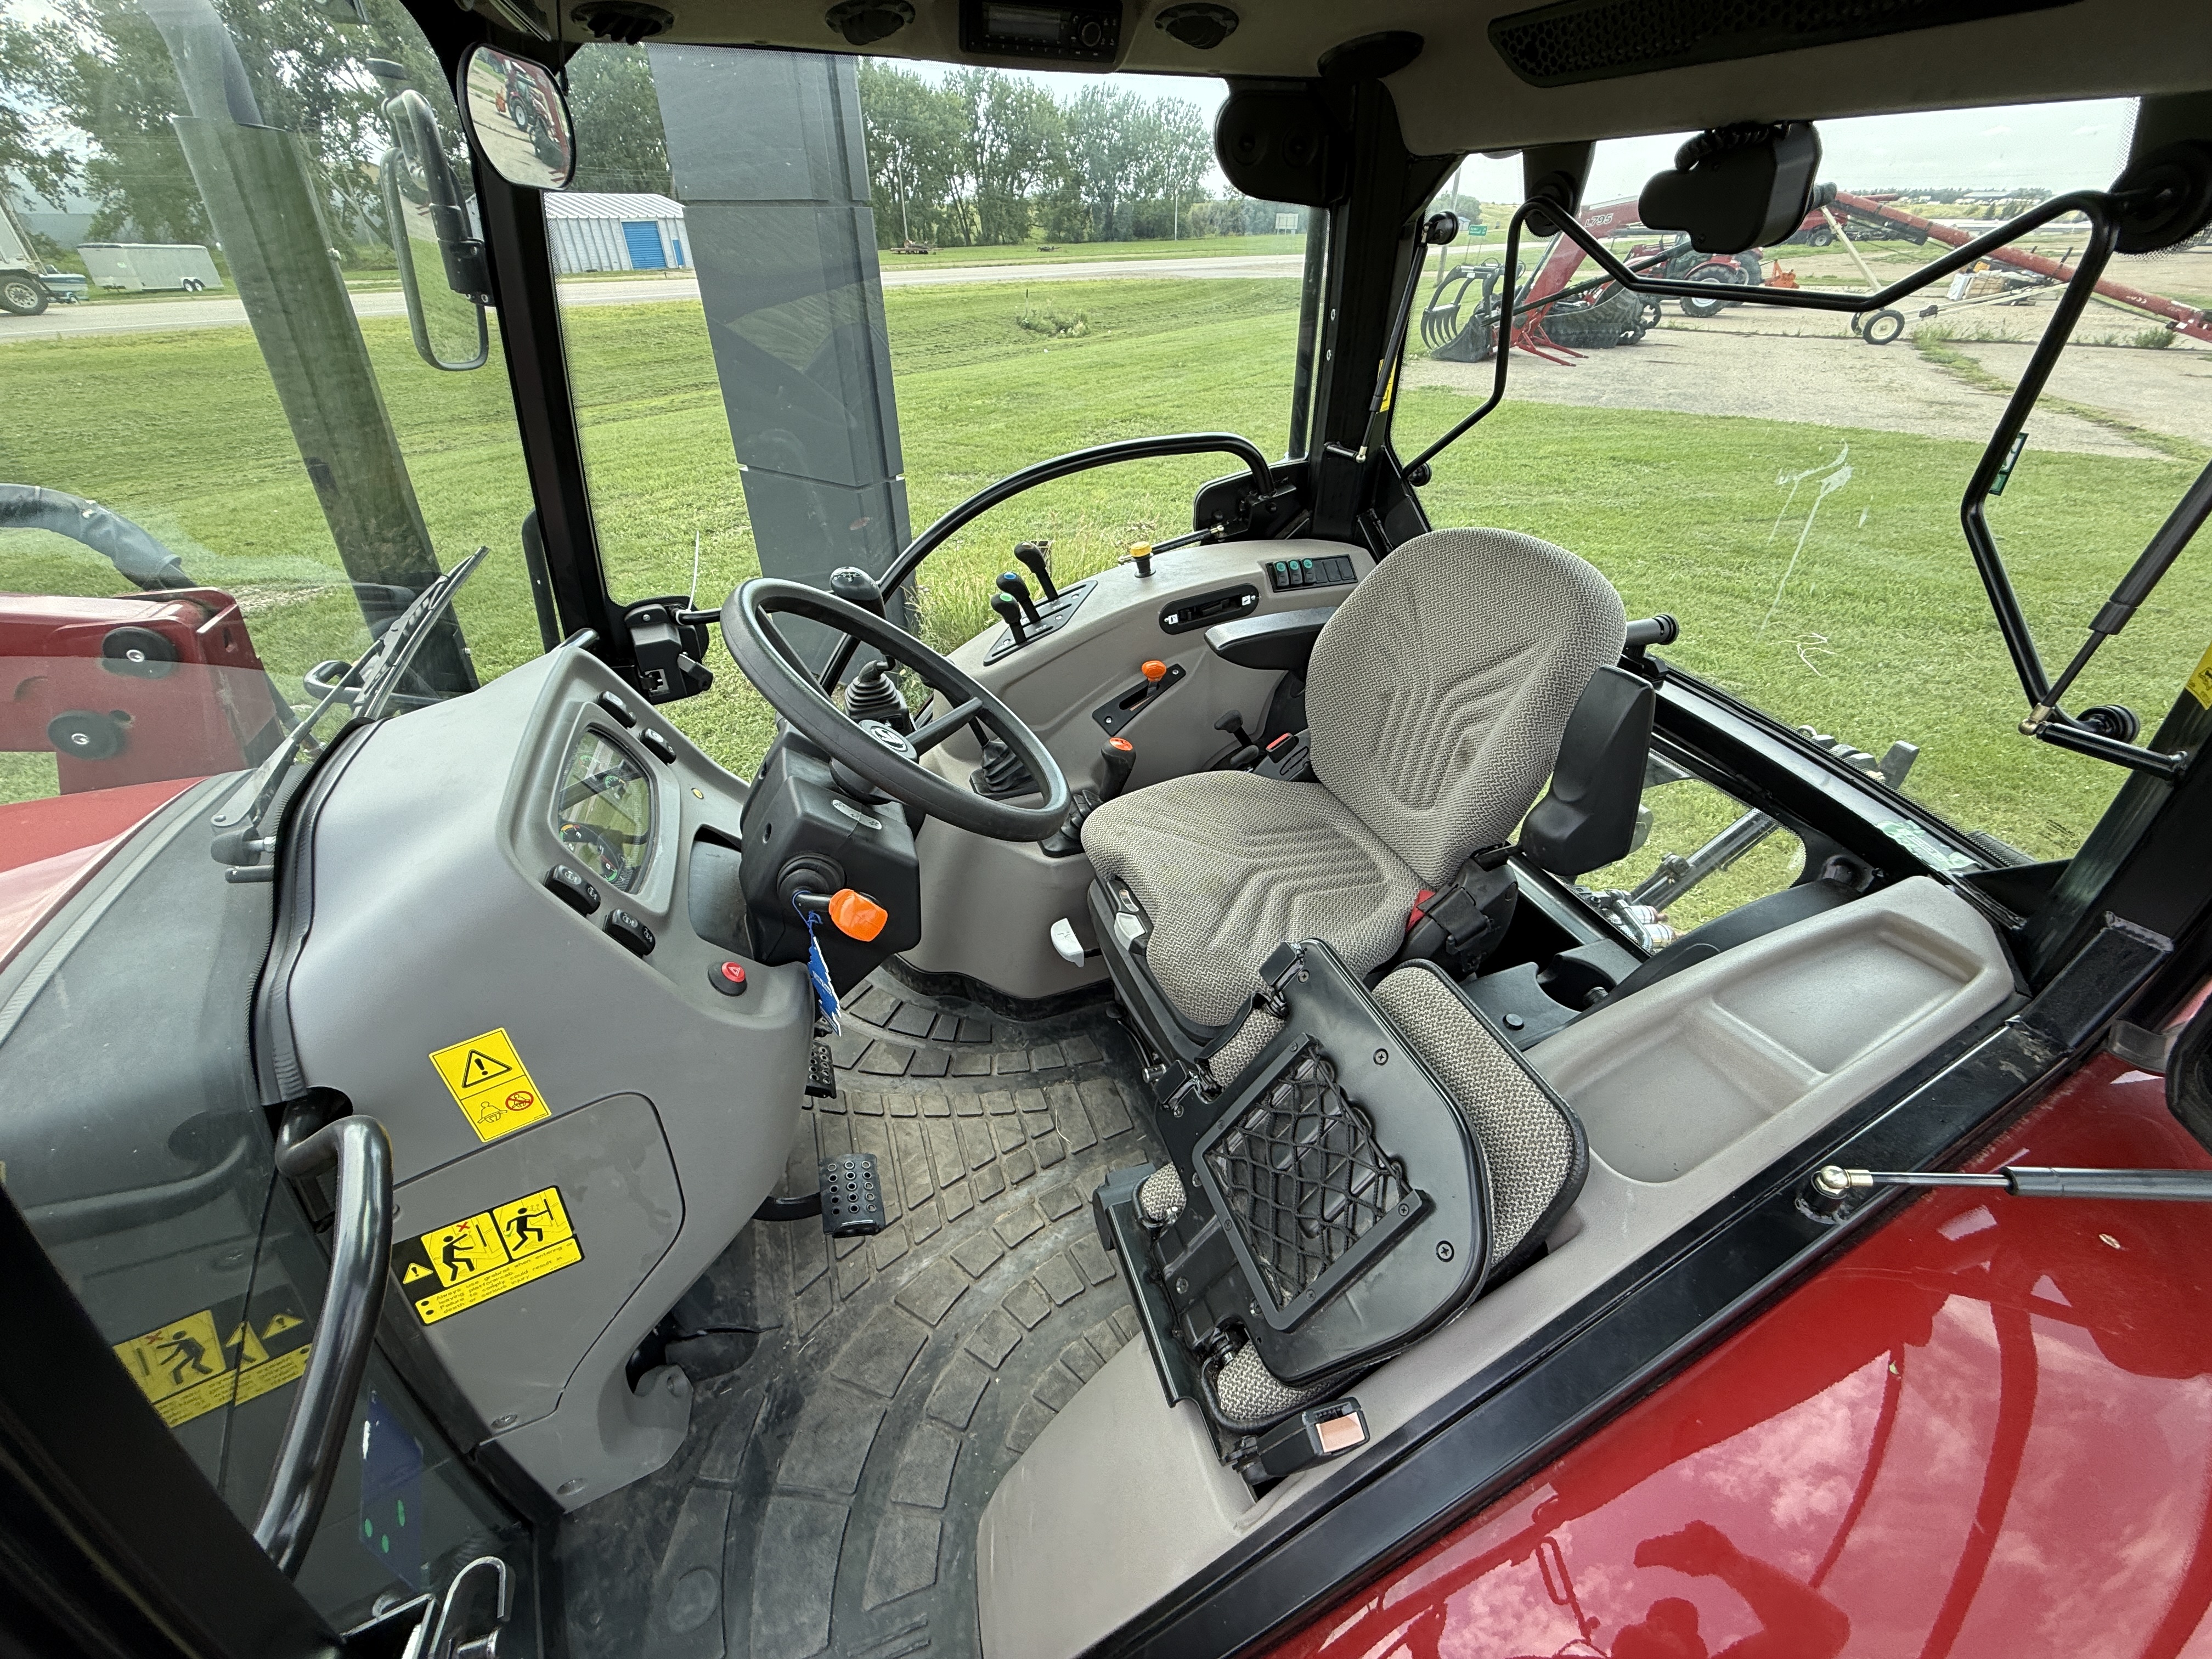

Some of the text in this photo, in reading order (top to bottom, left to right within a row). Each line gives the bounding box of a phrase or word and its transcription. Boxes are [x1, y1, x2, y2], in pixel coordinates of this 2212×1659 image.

[1585, 214, 1613, 228] L795
[437, 1288, 461, 1300] Always
[536, 1247, 562, 1259] entering
[440, 1298, 464, 1309] Failure
[511, 1270, 528, 1279] could
[533, 1261, 552, 1271] result
[439, 1293, 464, 1304] leaving
[444, 1303, 465, 1313] death
[481, 1285, 506, 1297] serious
[511, 1276, 528, 1285] injury
